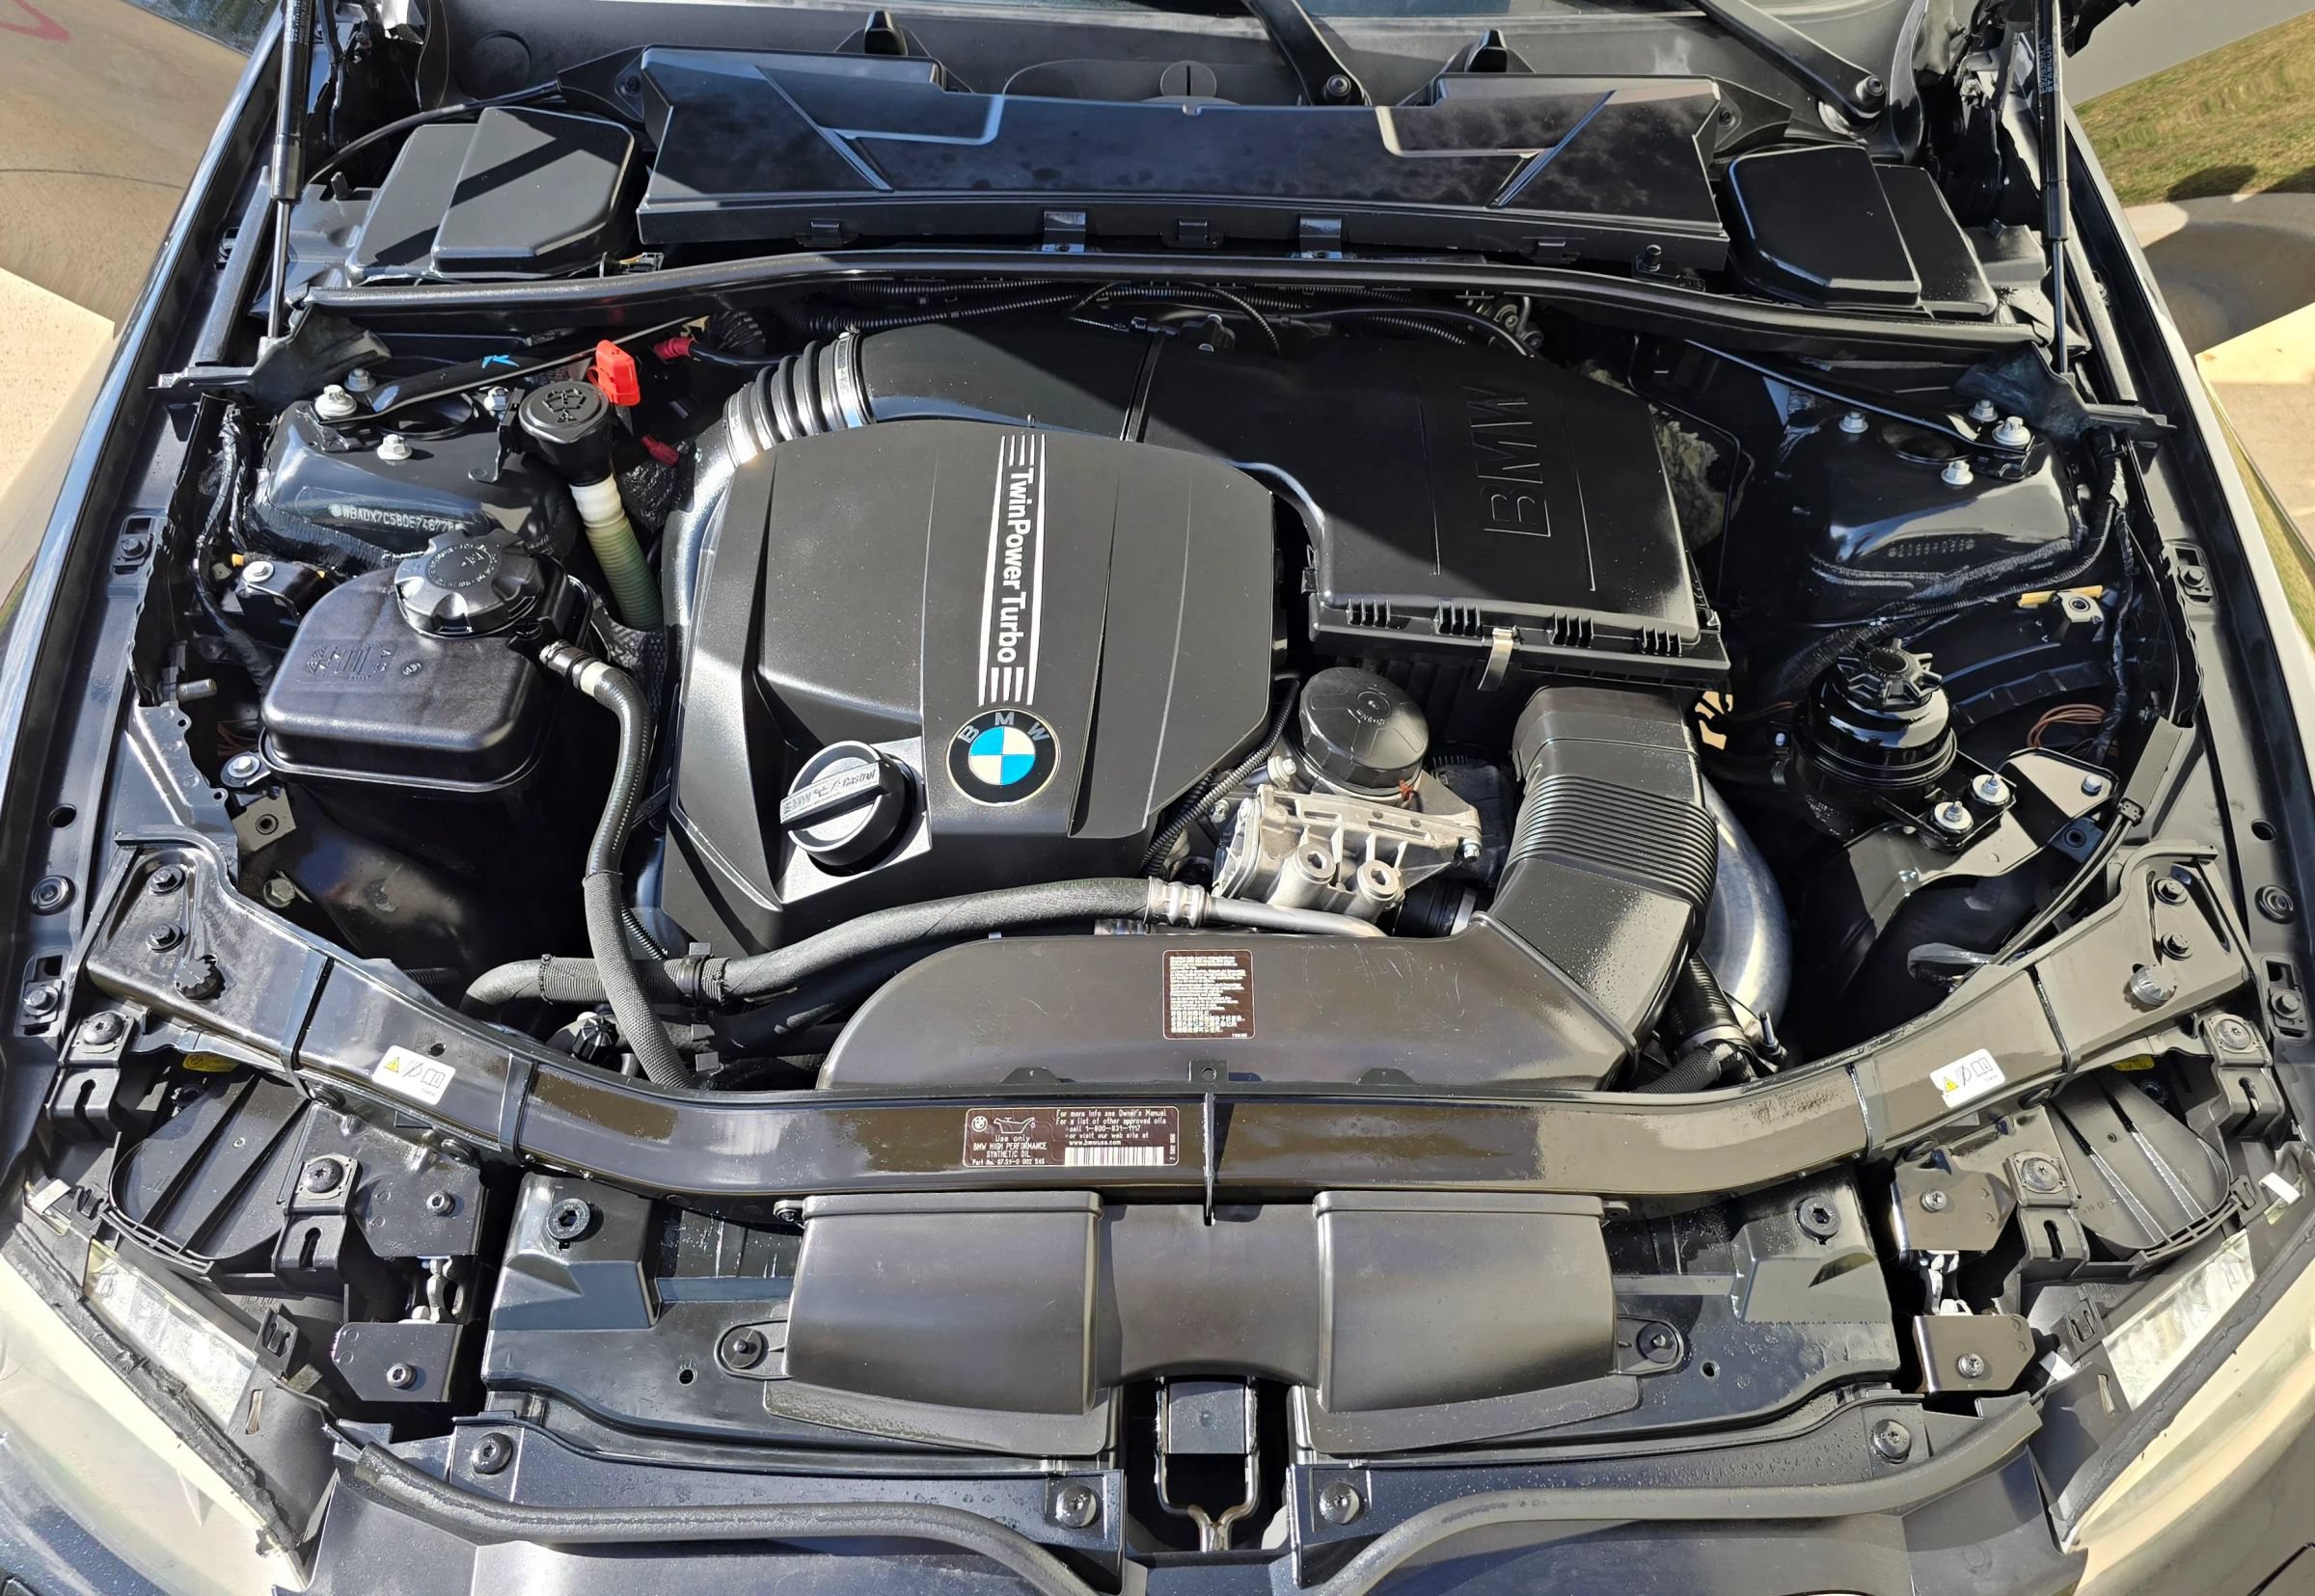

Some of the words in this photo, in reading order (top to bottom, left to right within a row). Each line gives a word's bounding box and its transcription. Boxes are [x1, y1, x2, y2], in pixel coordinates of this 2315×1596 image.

[1462, 386, 1552, 538] BMW
[1003, 467, 1034, 586] TwinPower
[997, 591, 1027, 663] Turbo
[958, 712, 1050, 744] BMW
[1123, 1117, 1151, 1126] approved
[1006, 1142, 1047, 1150] PERFORMANCE
[1013, 1134, 1030, 1143] only
[986, 1150, 1019, 1158] SYNTHETIC
